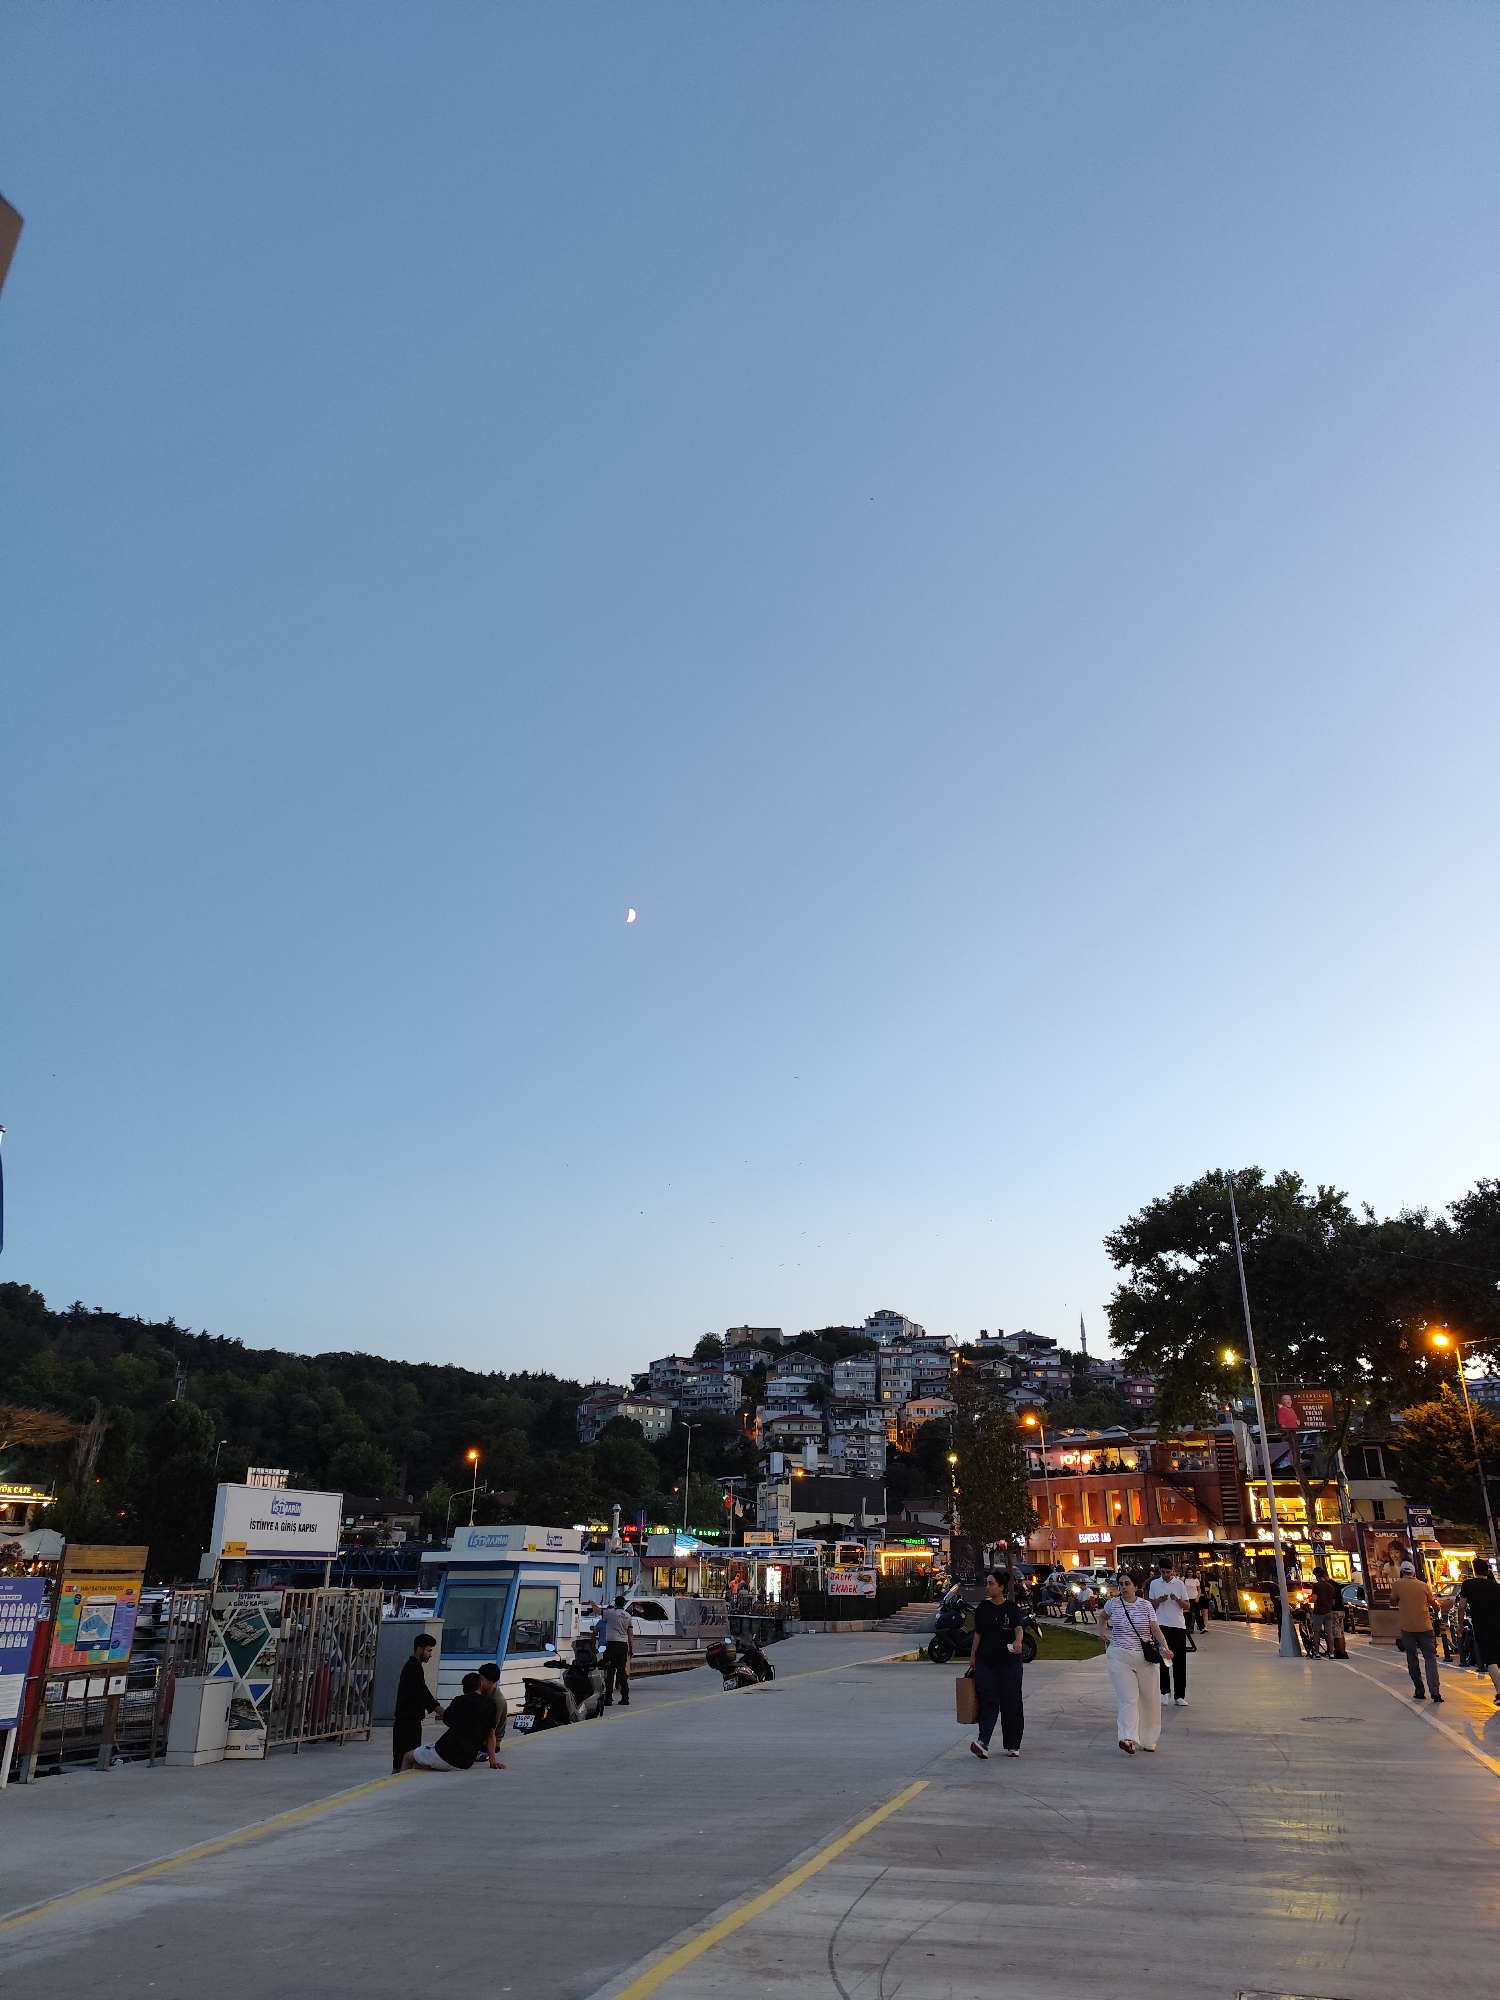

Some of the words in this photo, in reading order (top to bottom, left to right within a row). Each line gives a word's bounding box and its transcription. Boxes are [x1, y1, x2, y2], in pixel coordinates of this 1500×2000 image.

[249, 1518, 274, 1531] İSTİNYE
[274, 1523, 279, 1531] A
[280, 1520, 297, 1535] GİRİŞ
[297, 1523, 318, 1533] KAPISI
[830, 1584, 858, 1593] EKMEK
